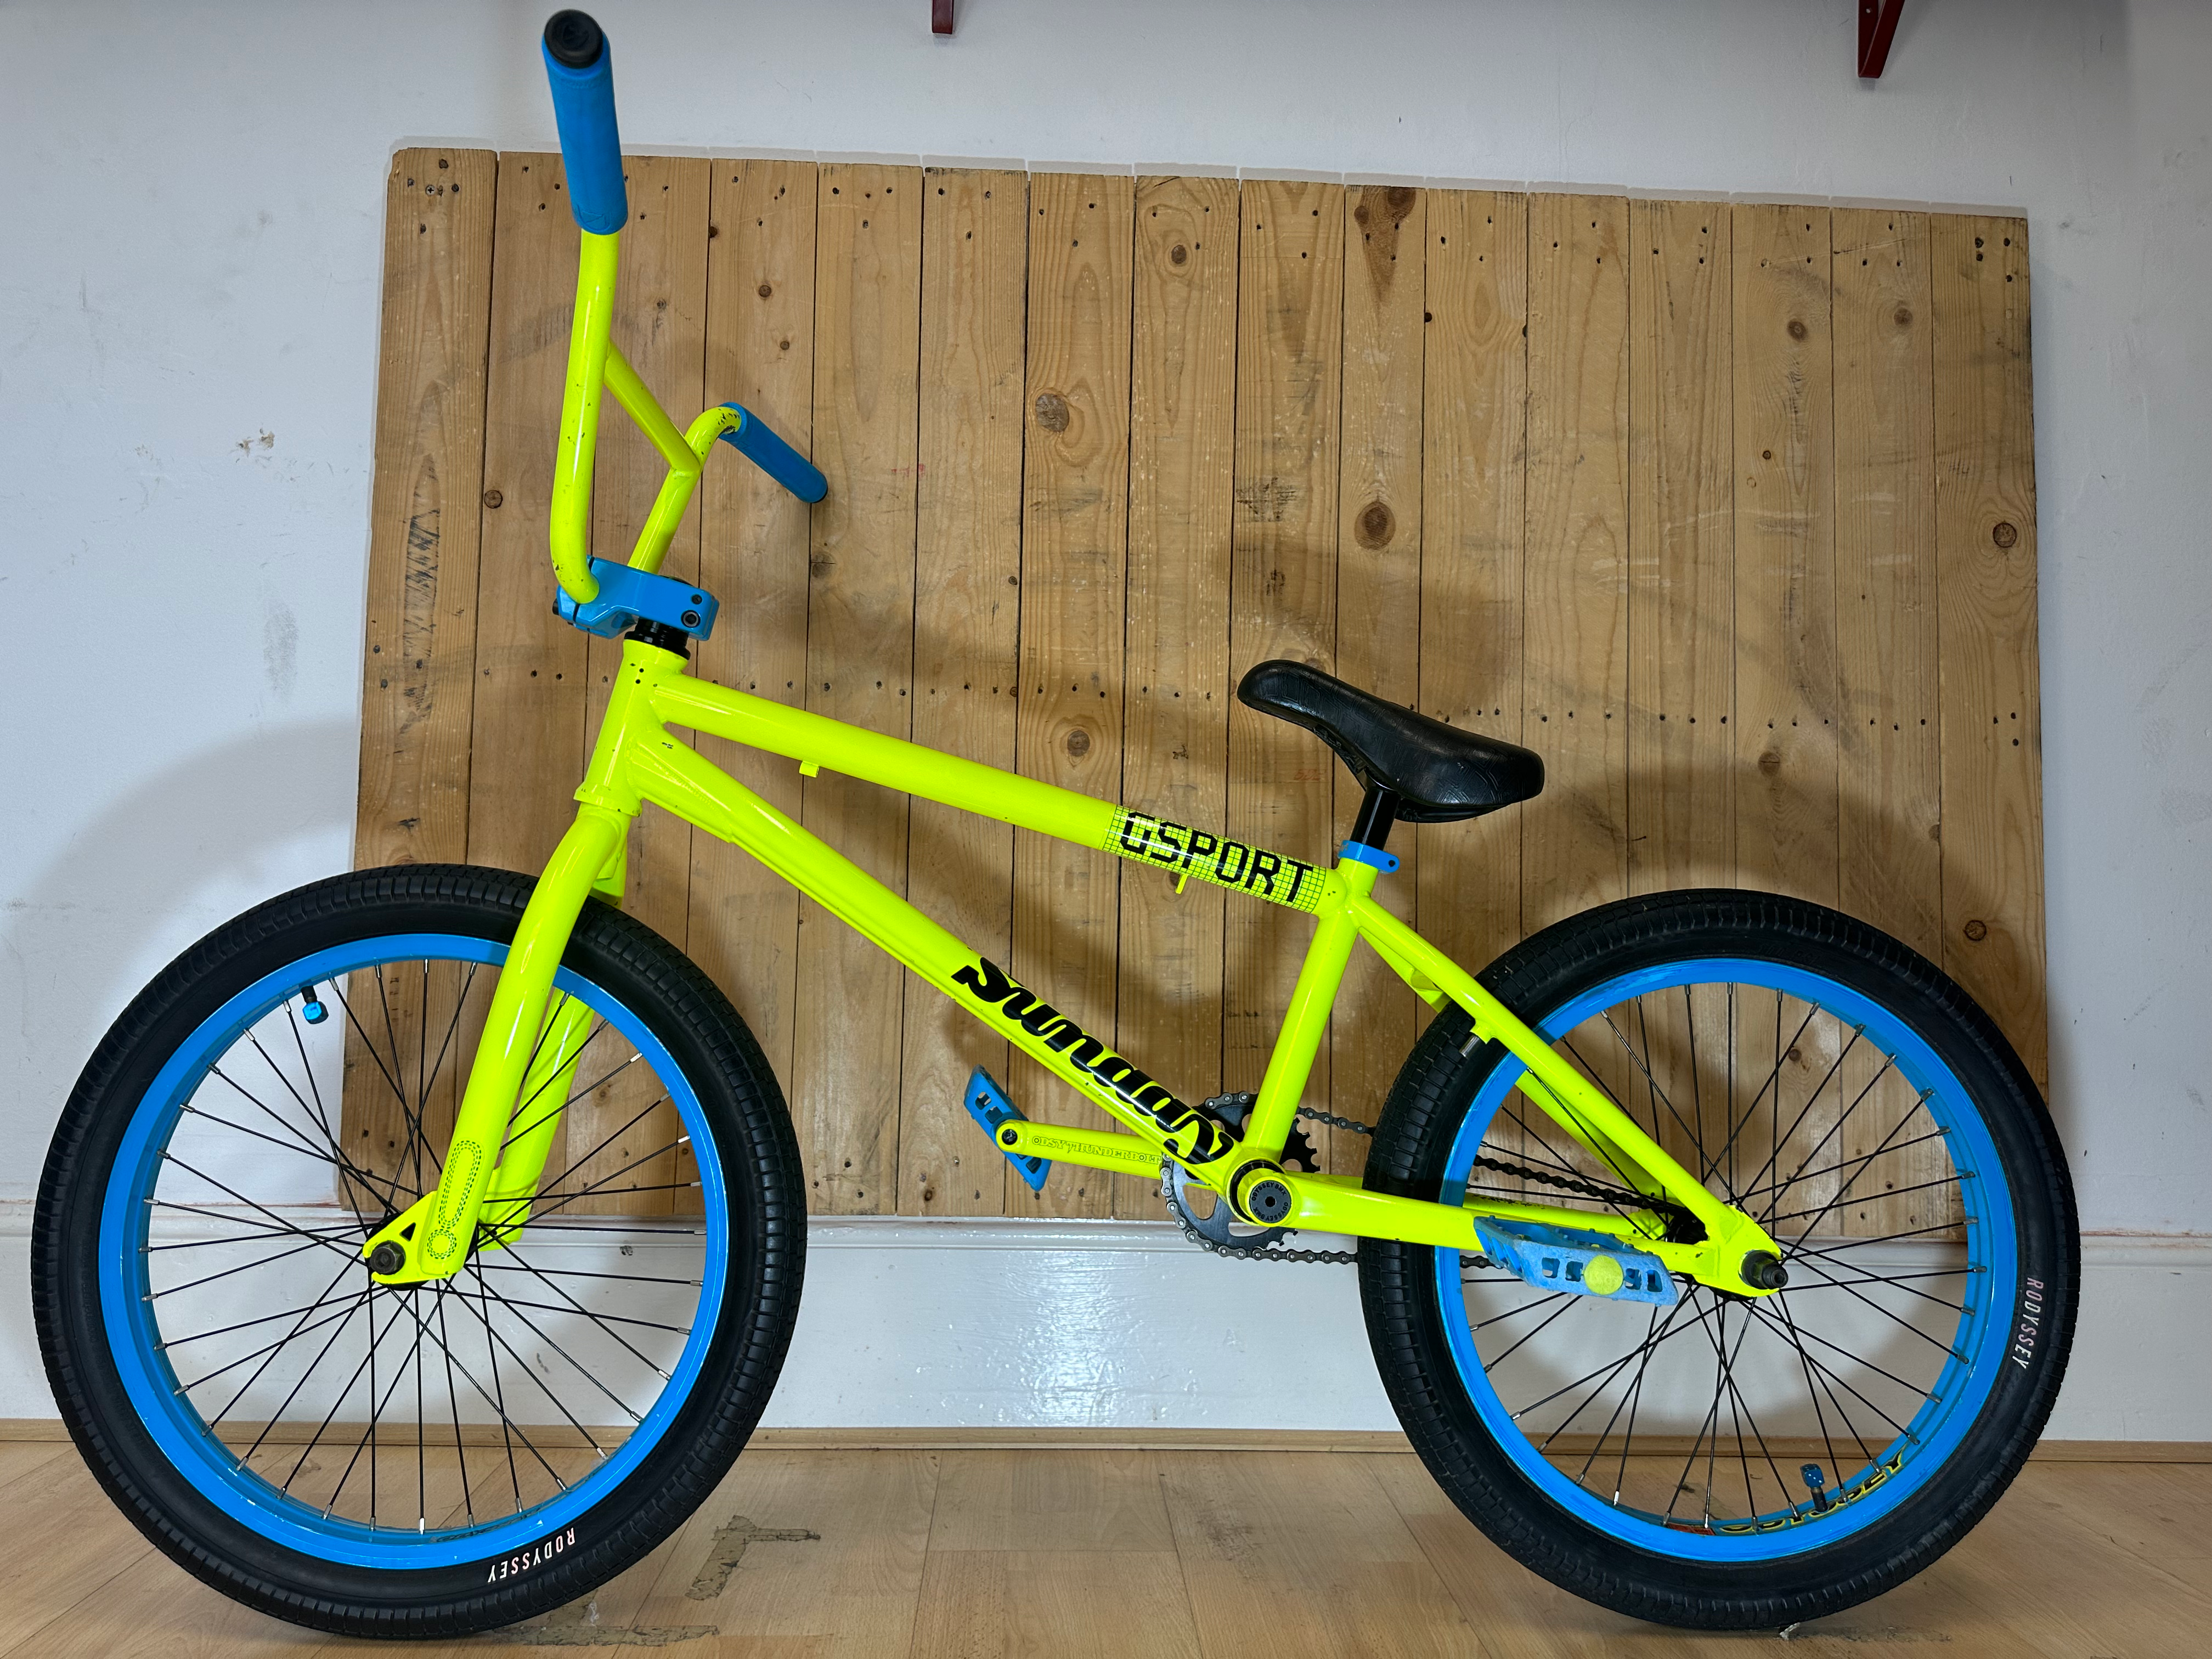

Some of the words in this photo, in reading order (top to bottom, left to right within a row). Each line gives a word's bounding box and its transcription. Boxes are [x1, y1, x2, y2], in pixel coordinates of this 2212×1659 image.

[1120, 811, 1313, 903] GSPORT
[1031, 1136, 1067, 1149] ODSY
[1065, 1141, 1162, 1165] THUNDERBOLT
[1251, 1182, 1274, 1201] ODYSSEY
[1274, 1183, 1287, 1196] BMX
[1253, 1206, 1265, 1220] BMX
[1265, 1201, 1289, 1221] ODYSSEY
[2012, 1277, 2045, 1369] RODYSSEY
[487, 1527, 576, 1583] RODYSSEY
